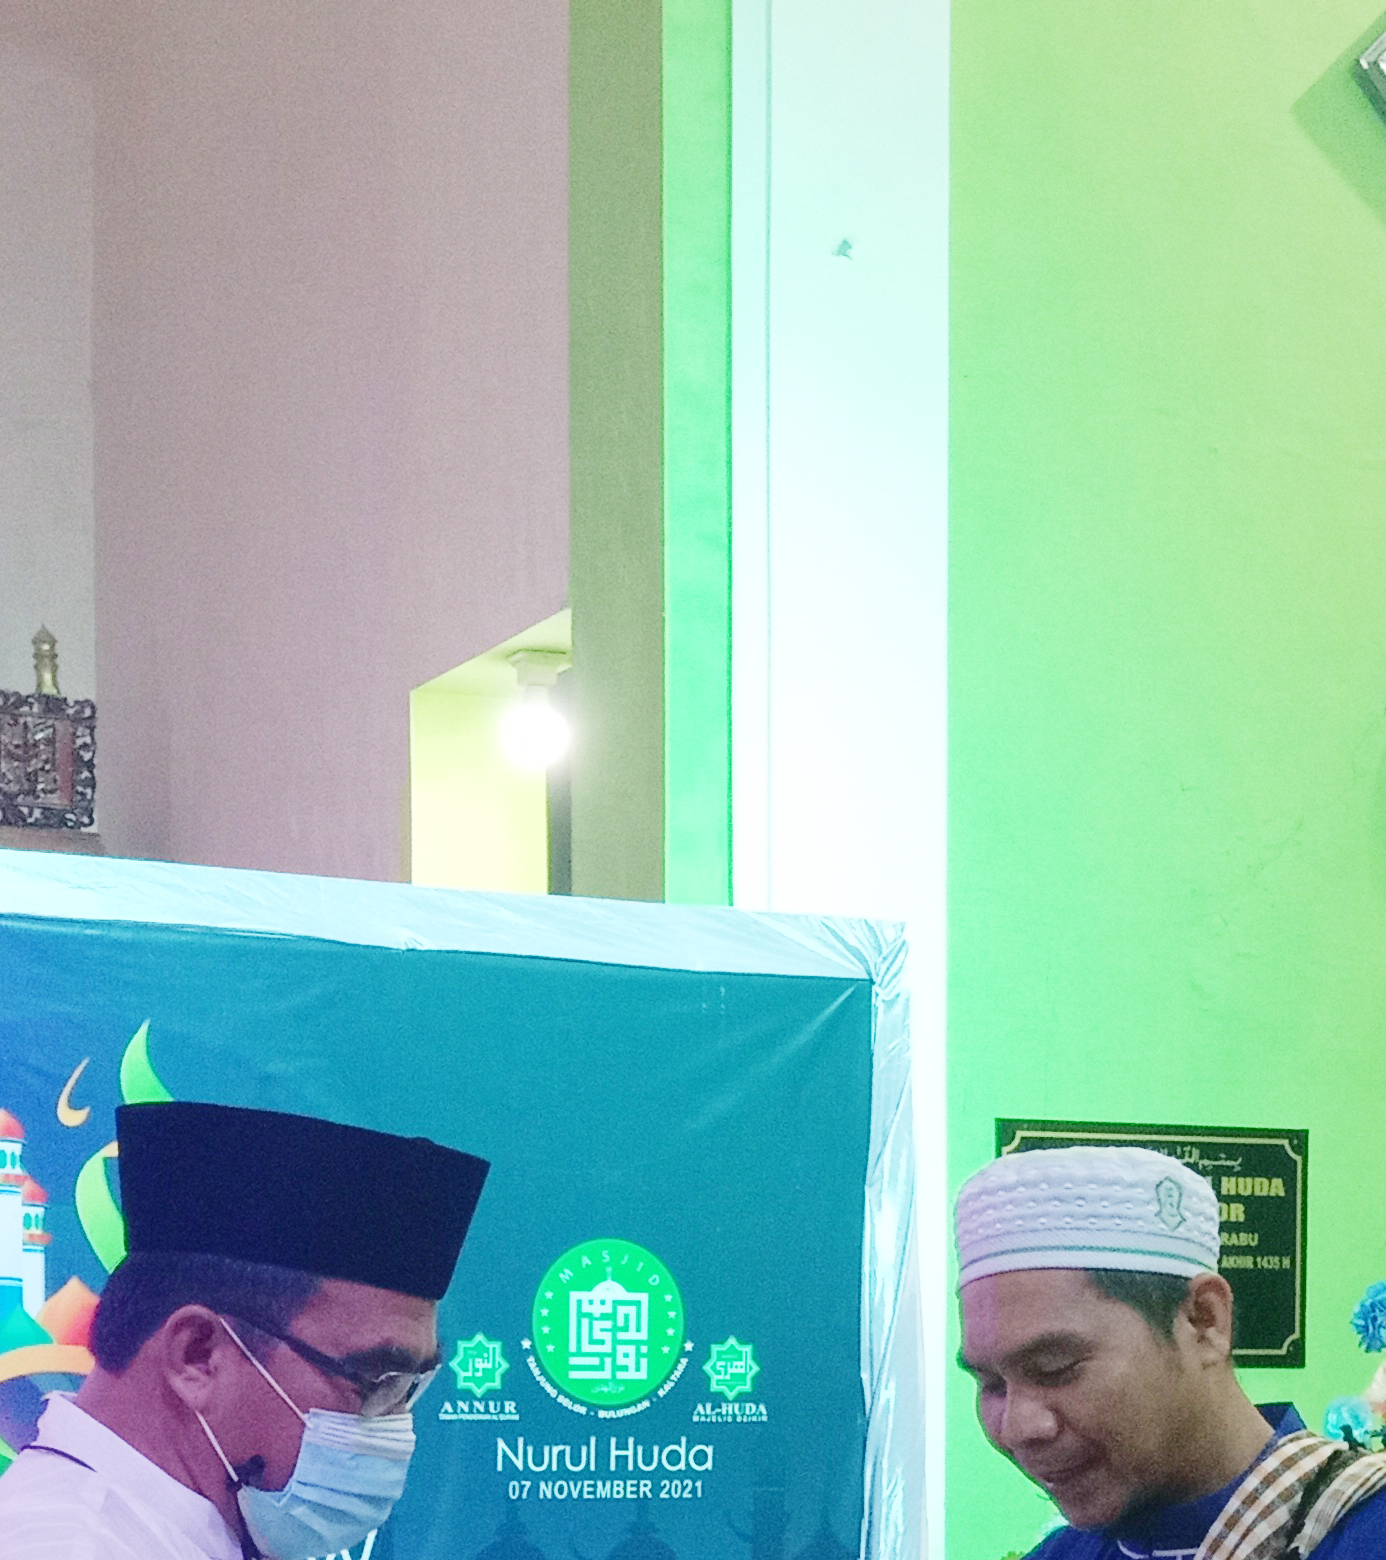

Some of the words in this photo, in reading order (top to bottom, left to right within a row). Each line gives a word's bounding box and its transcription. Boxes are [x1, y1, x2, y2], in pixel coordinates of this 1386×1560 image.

[1220, 1177, 1286, 1197] HUDA
[558, 1250, 660, 1286] MASJID
[439, 1400, 518, 1414] ANNUR
[693, 1402, 768, 1415] AL-HUDA
[496, 1435, 597, 1473] Nurul
[609, 1435, 714, 1472] Huda
[508, 1480, 532, 1500] 07
[538, 1479, 653, 1500] NOVEMBER
[659, 1479, 704, 1499] 2021
